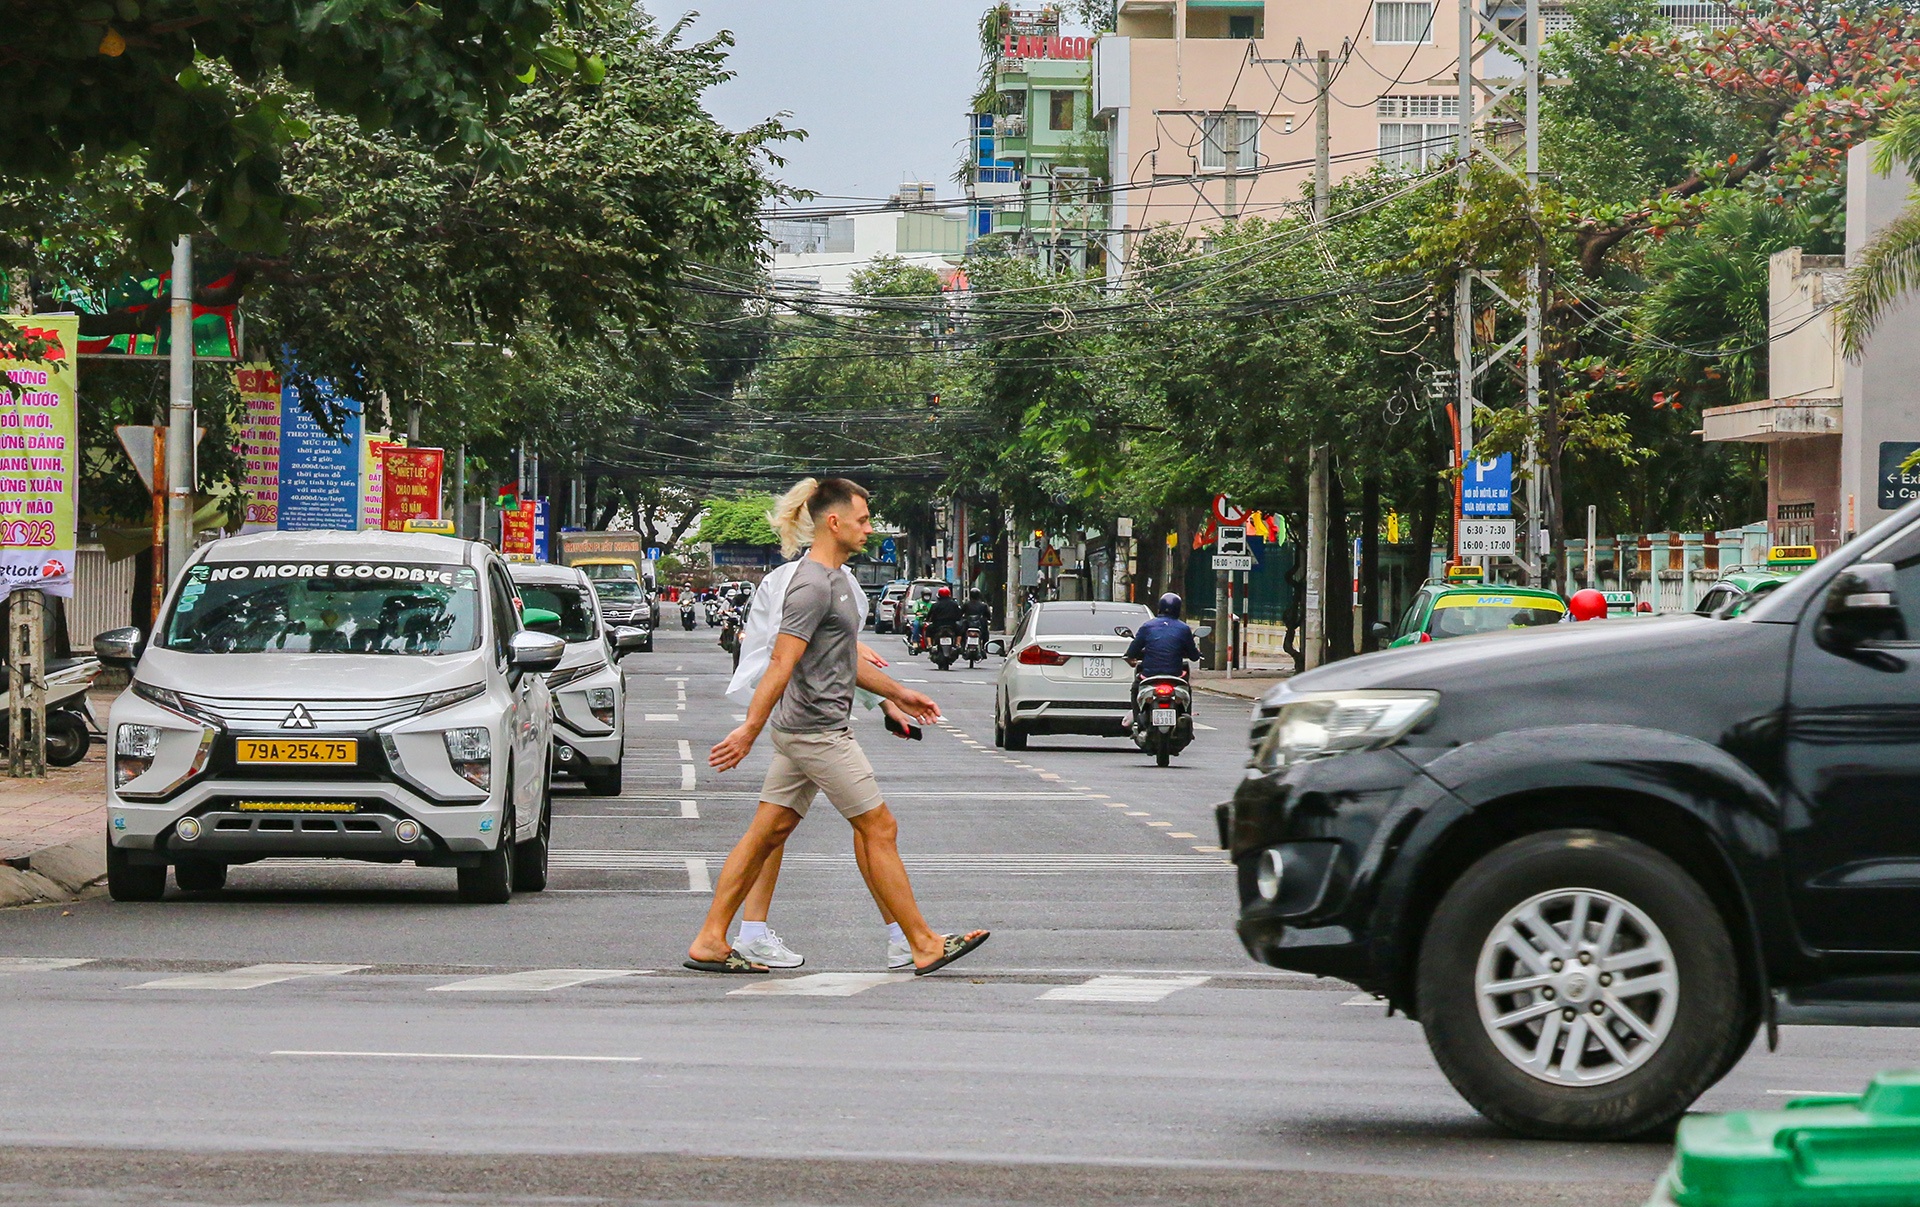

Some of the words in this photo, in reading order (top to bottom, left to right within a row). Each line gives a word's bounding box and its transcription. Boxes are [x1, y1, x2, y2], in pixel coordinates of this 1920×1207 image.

[1005, 35, 1044, 58] LAN
[22, 391, 59, 406] NƯỚC
[23, 413, 53, 429] MỚI,
[0, 433, 25, 449] ỪNG
[28, 432, 65, 450] ĐẢNG
[31, 457, 65, 472] VINH,
[1476, 455, 1497, 482] P
[30, 476, 63, 492] XUÂN
[27, 498, 53, 514] MÃO
[400, 502, 408, 513] 93
[1, 519, 55, 547] 2023
[1466, 526, 1483, 535] 6:30
[1490, 526, 1506, 535] 7:30
[1463, 541, 1483, 550] 16:00
[1490, 541, 1511, 550] 17:00
[210, 566, 250, 582] NO
[253, 564, 329, 579] MORE
[334, 565, 453, 585] GOODBYE
[1477, 597, 1514, 605] MPE
[1089, 658, 1105, 668] 79A
[1084, 667, 1112, 677] 12393
[246, 743, 348, 760] 79A-254.75
